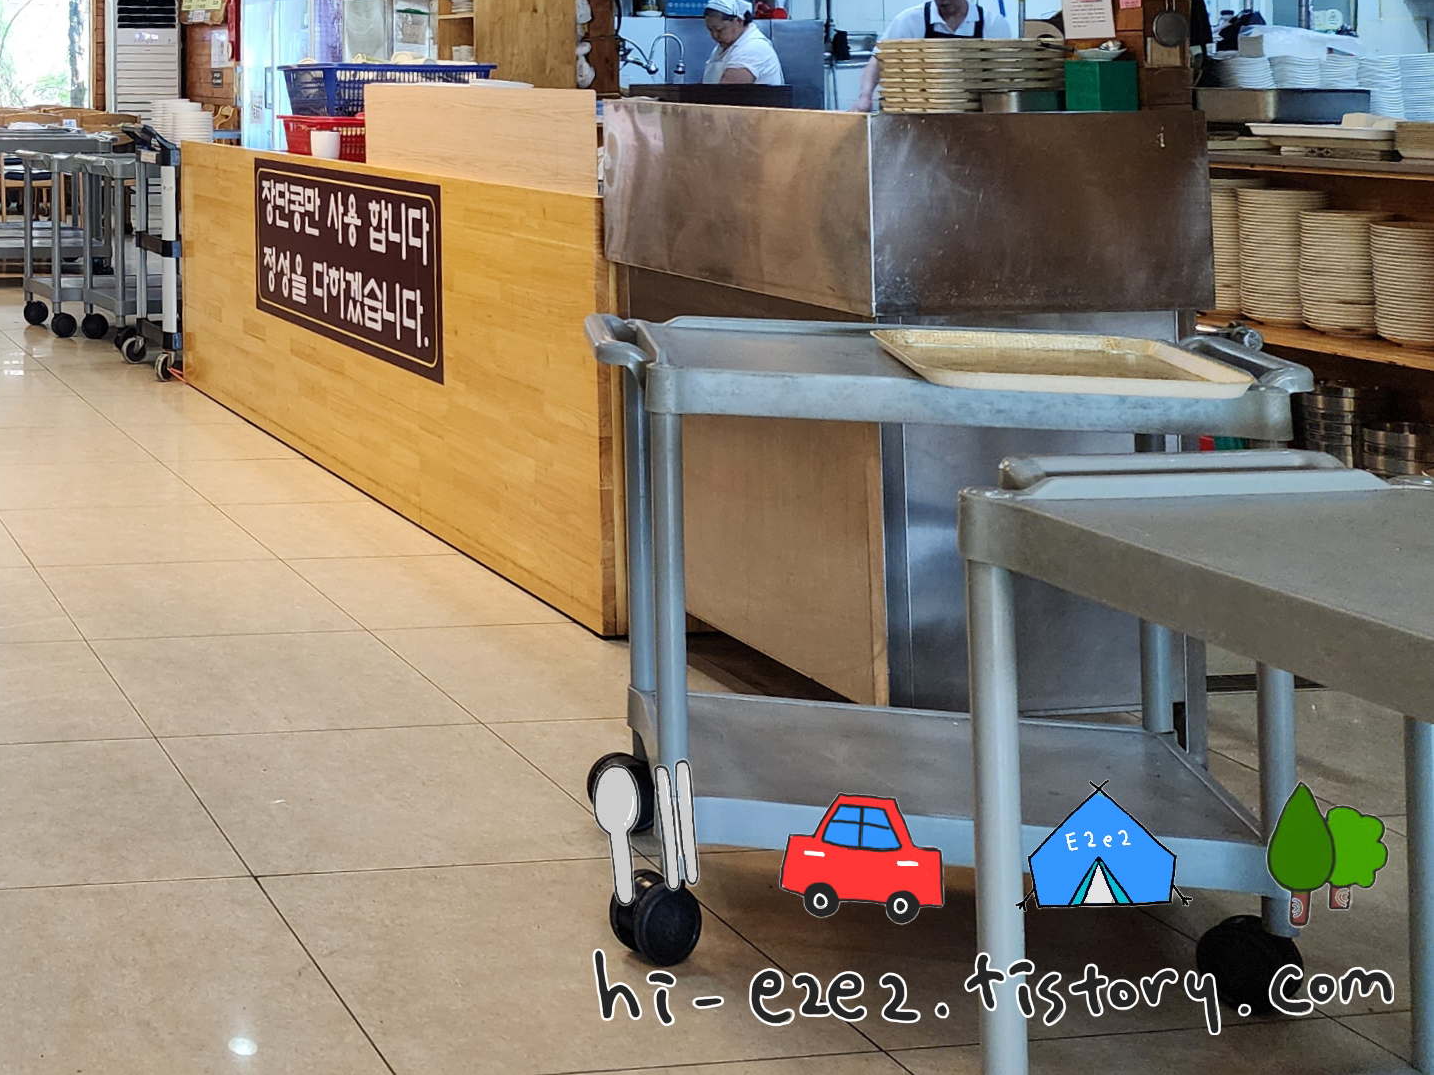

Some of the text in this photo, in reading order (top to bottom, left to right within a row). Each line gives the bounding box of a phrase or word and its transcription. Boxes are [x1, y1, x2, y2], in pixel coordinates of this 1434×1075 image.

[261, 179, 430, 266] 장단콩만 사용 합니다
[263, 246, 430, 348] 정성을 다하겠습니다.
